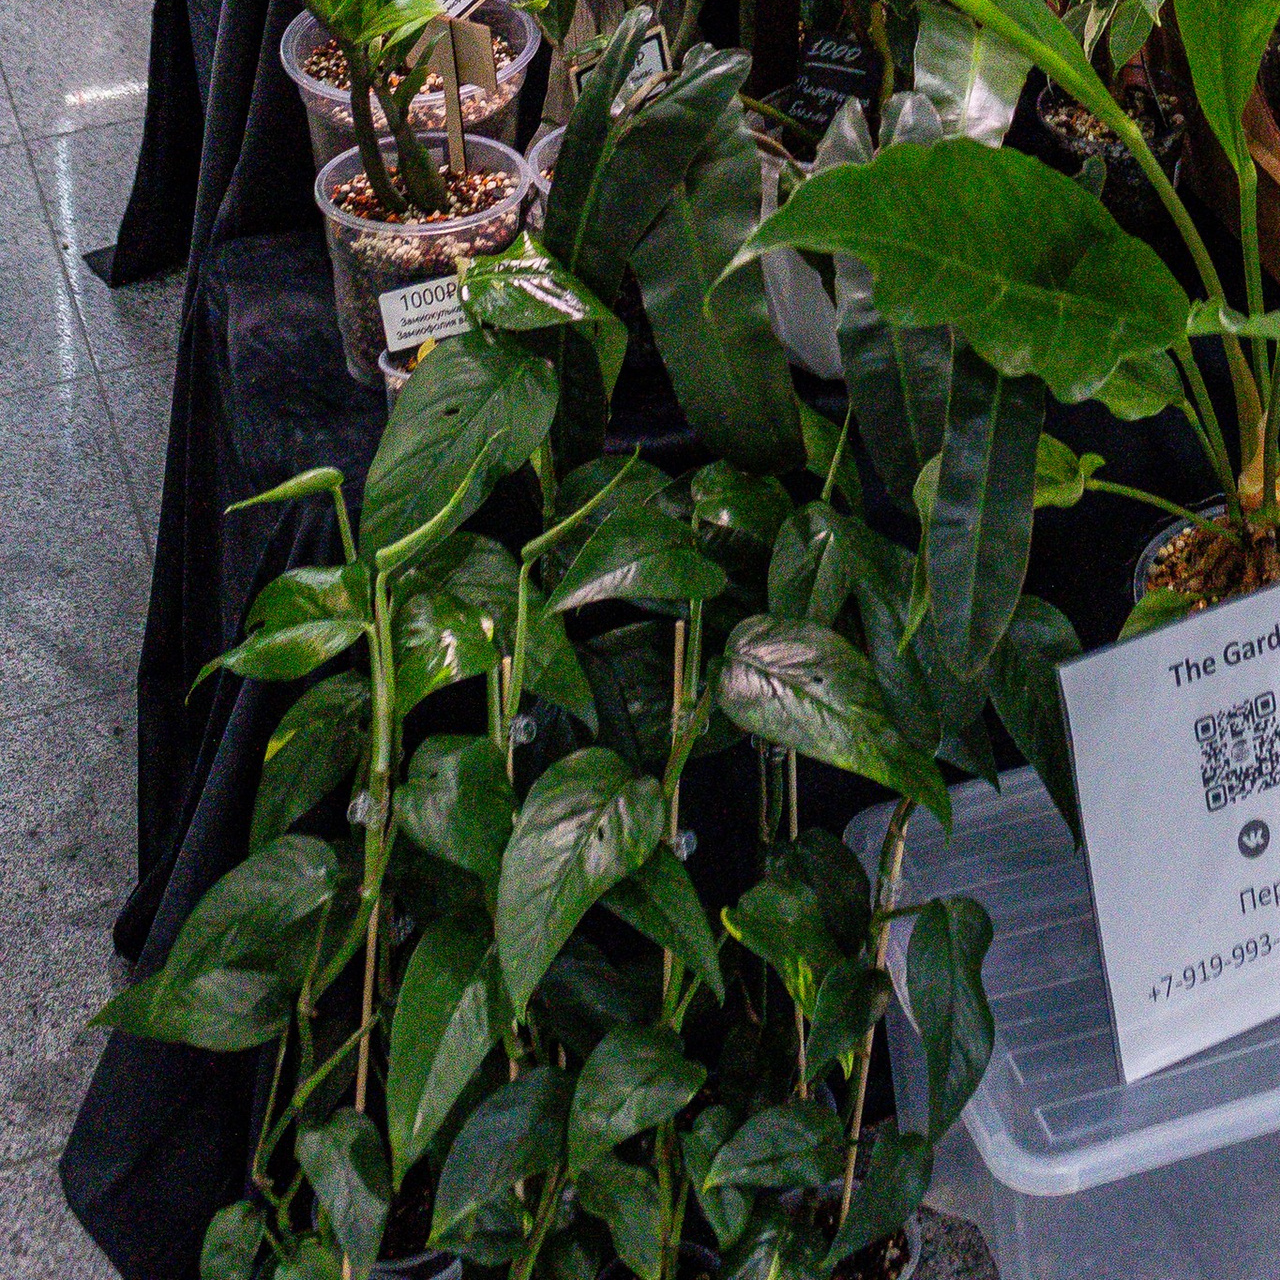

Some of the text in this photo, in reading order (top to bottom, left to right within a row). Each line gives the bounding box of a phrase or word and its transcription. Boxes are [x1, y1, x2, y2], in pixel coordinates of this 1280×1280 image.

[807, 38, 862, 62] 1000
[400, 283, 457, 311] 1000₽
[401, 306, 462, 327] Замиокулька
[1168, 653, 1217, 687] The
